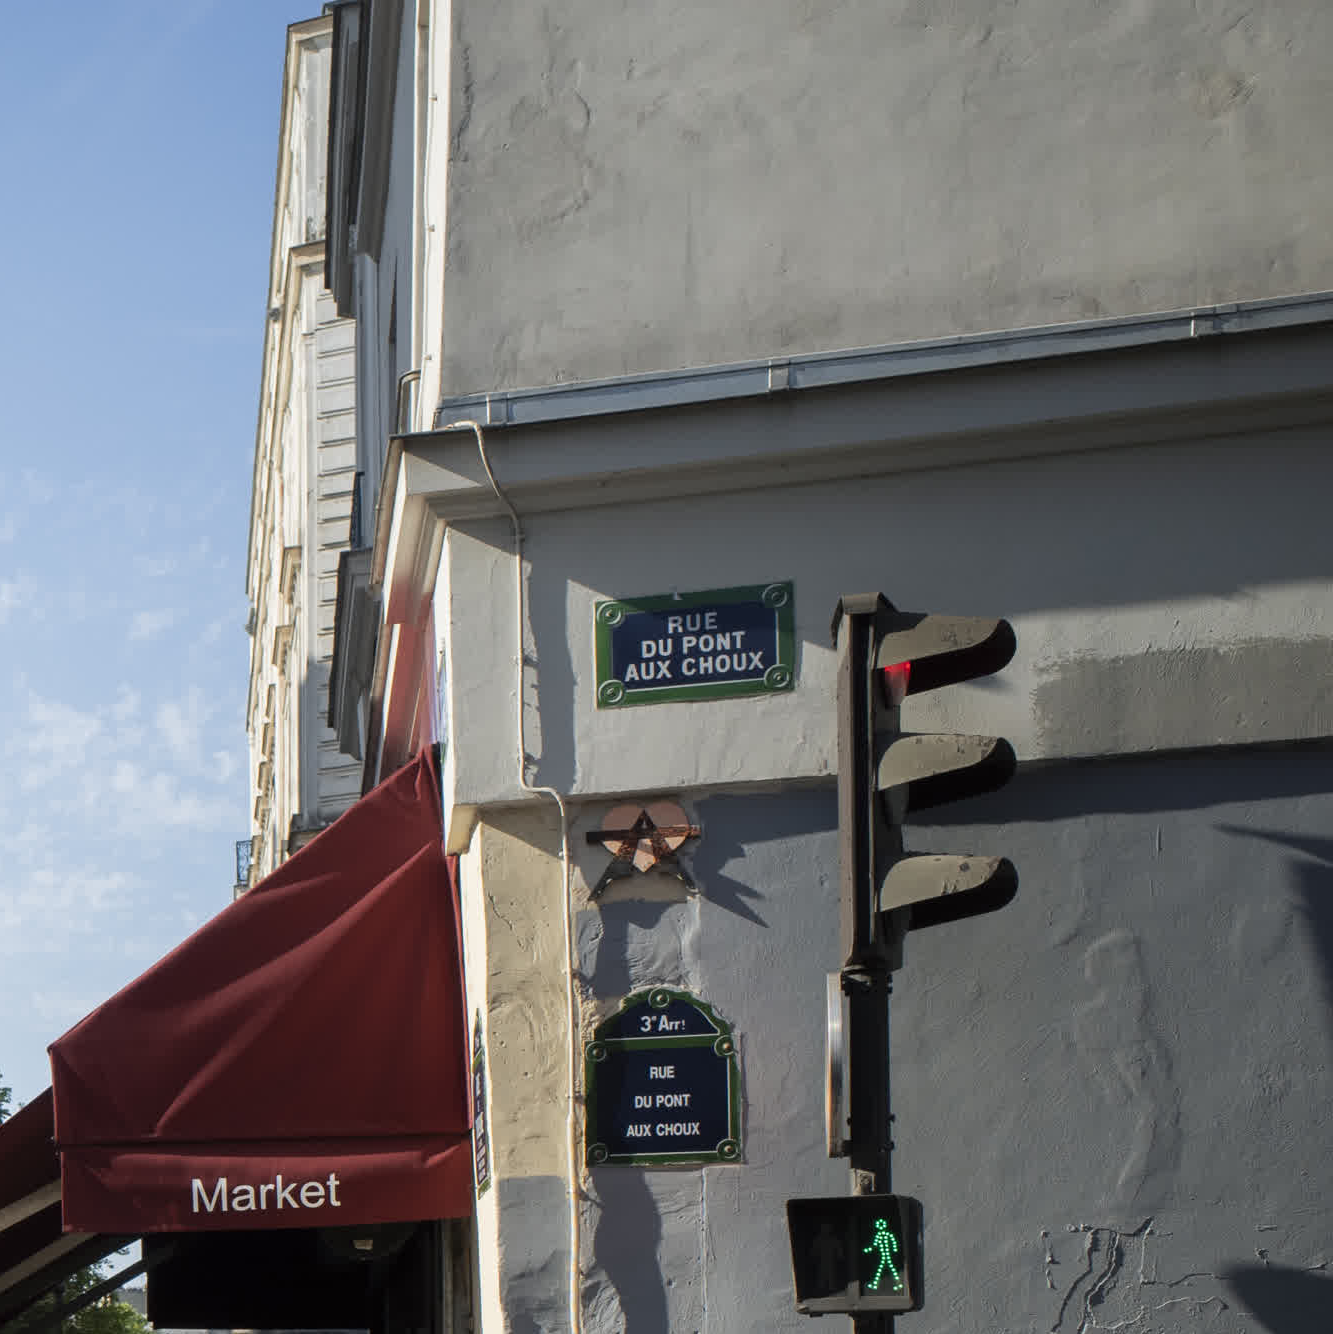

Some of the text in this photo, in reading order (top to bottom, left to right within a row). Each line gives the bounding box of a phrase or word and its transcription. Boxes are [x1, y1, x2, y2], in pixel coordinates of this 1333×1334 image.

[667, 611, 718, 634] RUE
[640, 630, 746, 659] DU PONT
[624, 650, 765, 682] AUX CHOUX
[649, 1065, 675, 1080] RUE
[634, 1093, 691, 1109] DU PONT
[626, 1122, 701, 1137] AUX CHOUX
[191, 1172, 342, 1213] Market
